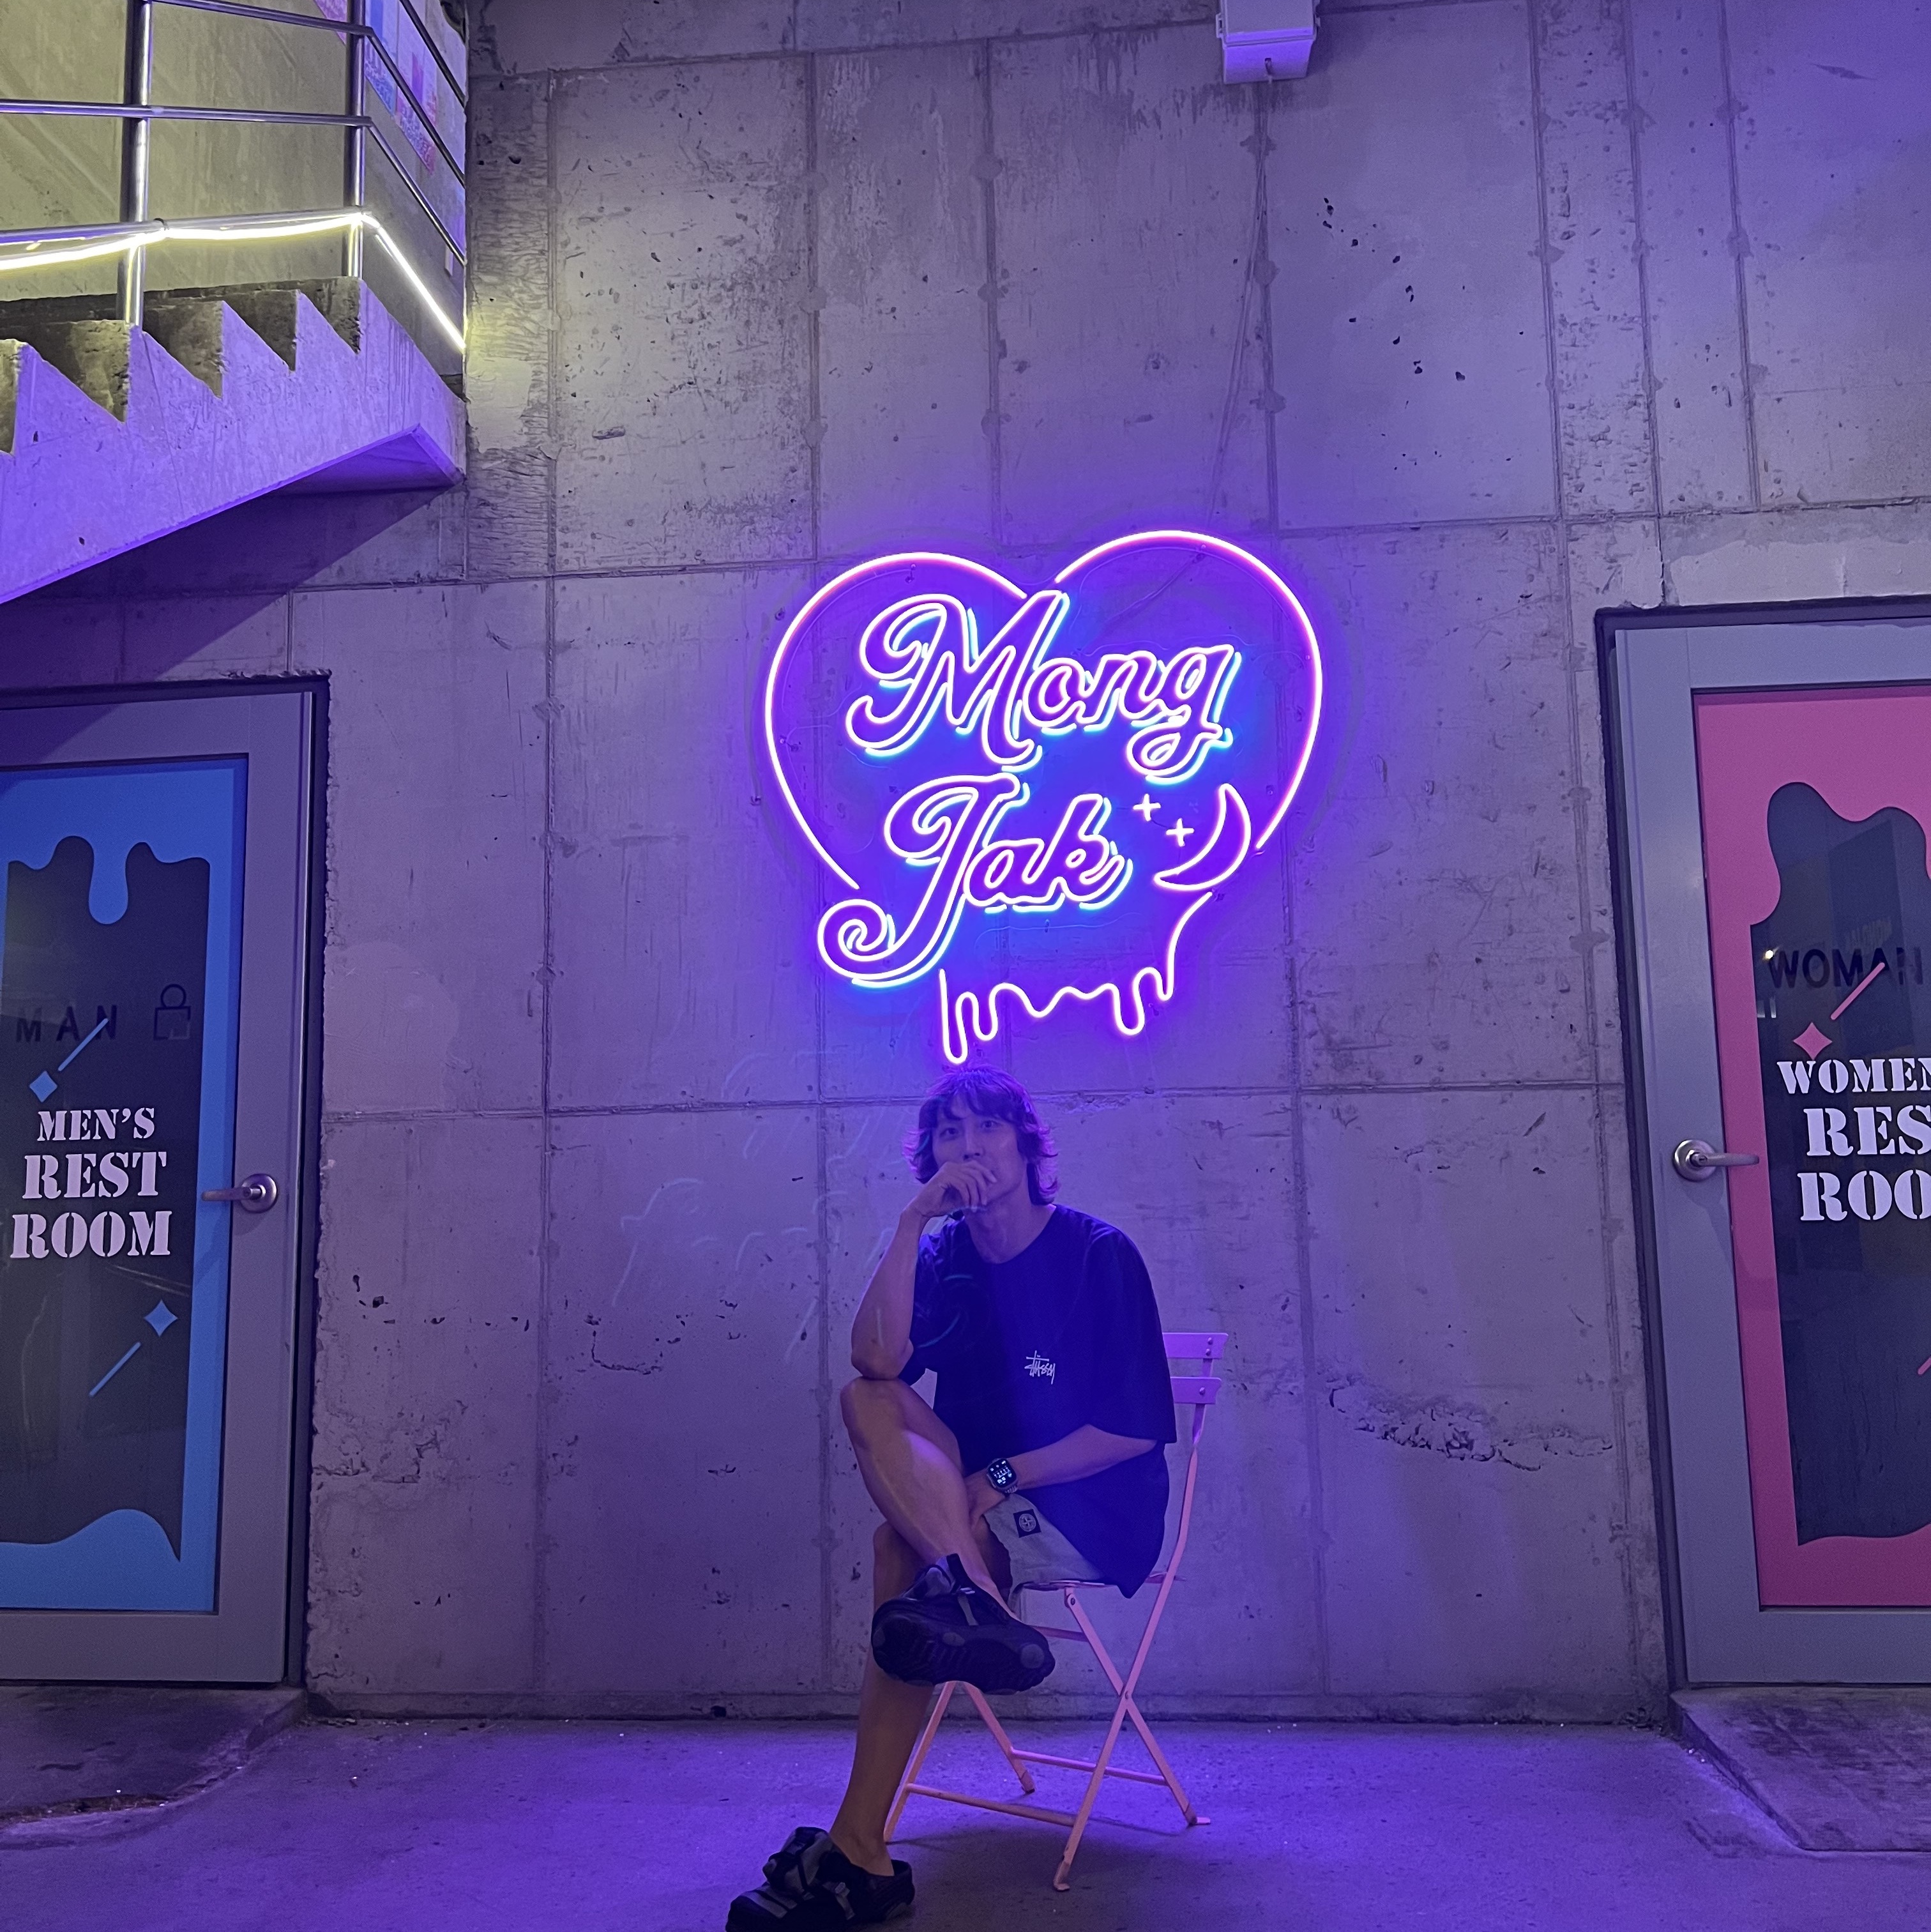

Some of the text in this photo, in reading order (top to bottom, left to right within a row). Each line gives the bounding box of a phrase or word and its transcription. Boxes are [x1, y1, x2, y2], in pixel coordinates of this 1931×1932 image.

[845, 589, 1242, 785] Mong
[817, 772, 1133, 989] Jak
[16, 1005, 117, 1042] MAN
[37, 1107, 155, 1141] MEN'S
[1803, 1105, 1931, 1156] RES
[22, 1152, 167, 1199] REST
[1797, 1169, 1931, 1221] ROO
[10, 1211, 172, 1258] ROOM
